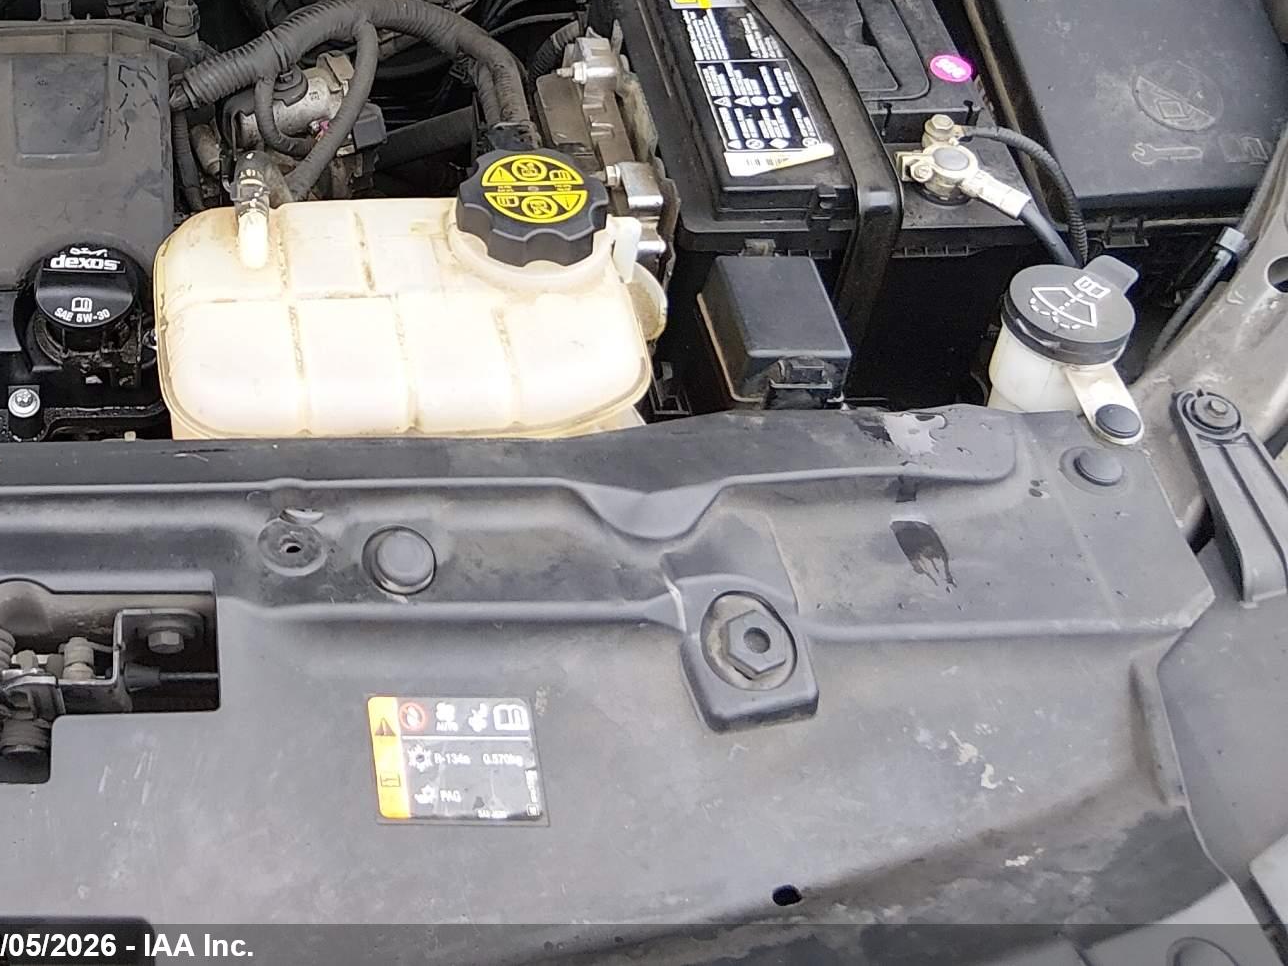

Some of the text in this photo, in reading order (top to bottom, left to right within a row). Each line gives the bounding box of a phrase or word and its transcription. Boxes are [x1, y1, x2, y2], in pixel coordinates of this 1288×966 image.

[50, 254, 120, 271] dexos
[54, 308, 110, 323] SAE 5W-30
